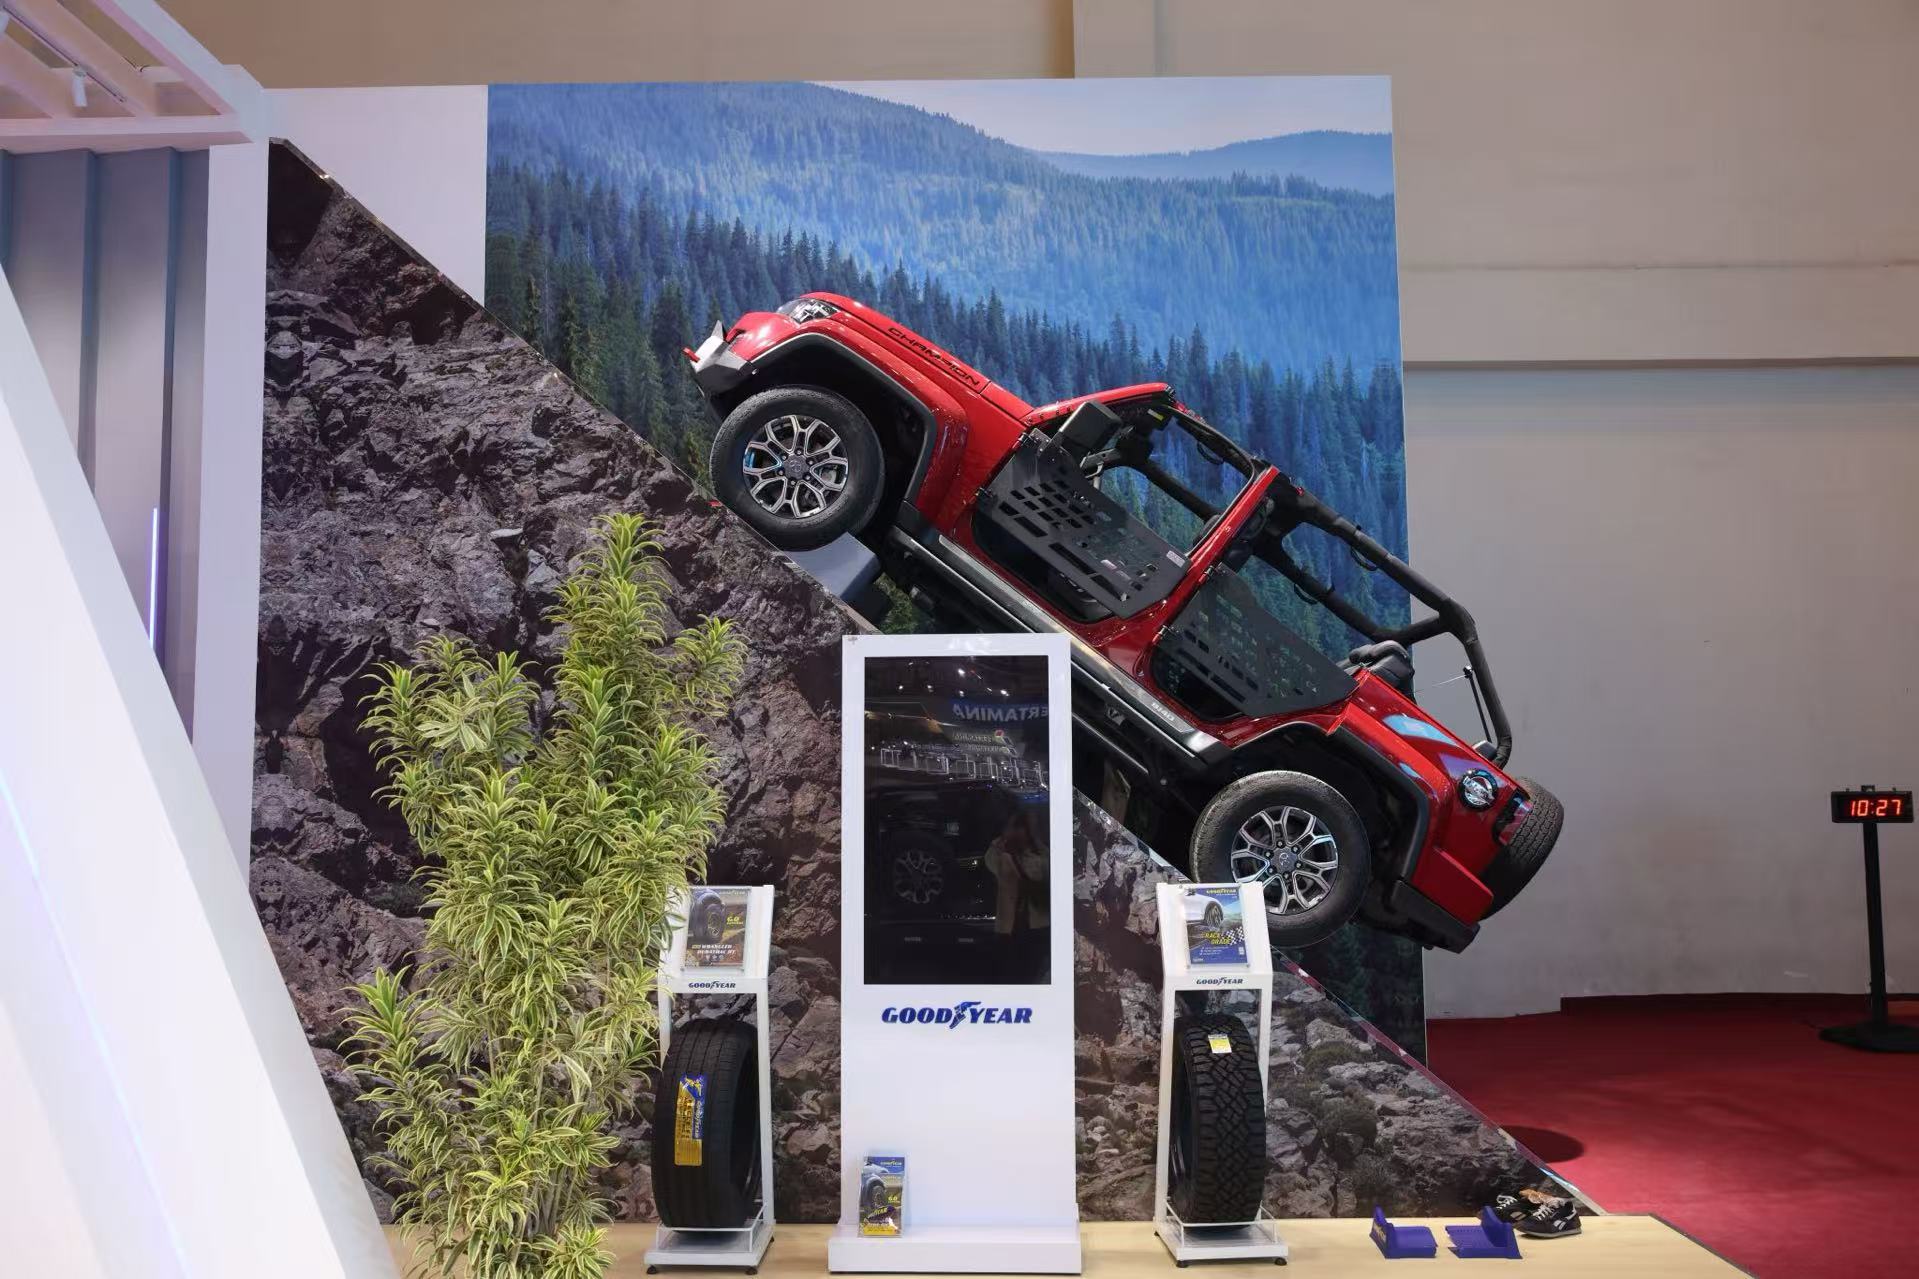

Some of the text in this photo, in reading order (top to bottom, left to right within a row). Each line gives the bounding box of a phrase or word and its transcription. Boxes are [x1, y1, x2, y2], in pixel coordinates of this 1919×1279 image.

[887, 326, 980, 386] CHAMPION
[1850, 799, 1902, 817] 10:27
[688, 980, 736, 989] GOODYEAR
[1196, 976, 1244, 986] GOODYEAR
[881, 1001, 1033, 1029] GOODYEAR
